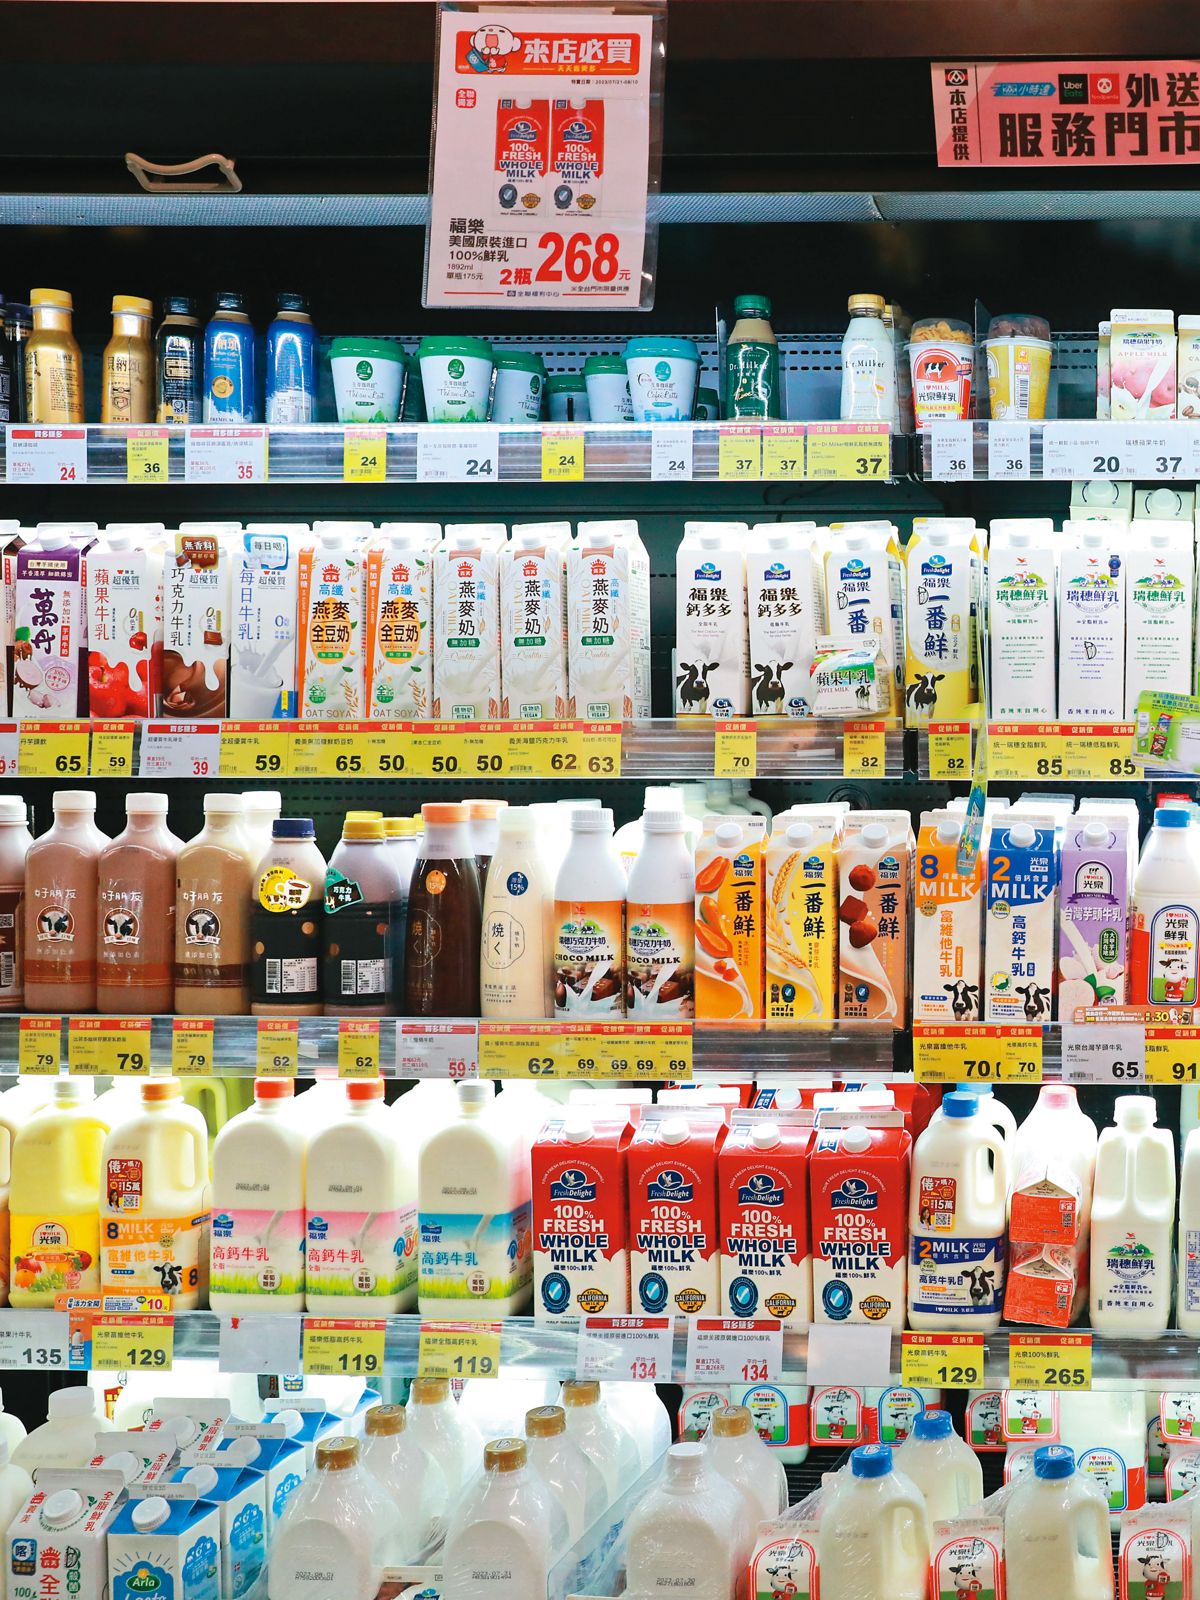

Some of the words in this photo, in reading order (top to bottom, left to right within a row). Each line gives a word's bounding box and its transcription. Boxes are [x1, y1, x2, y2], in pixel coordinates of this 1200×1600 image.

[523, 39, 632, 64] 來店必買
[1063, 81, 1083, 90] Uber
[1126, 73, 1200, 109] 外送
[457, 90, 475, 98] 全聯
[457, 98, 475, 108] 獨家
[950, 89, 970, 161] 本店提供
[510, 143, 535, 152] 100%
[502, 152, 542, 161] FRESH
[500, 161, 543, 171] WHOLE
[506, 170, 536, 178] MILK
[450, 218, 484, 234] 福樂
[449, 235, 528, 248] 美國原裝進口
[450, 251, 509, 262] 100%鮮乳
[500, 268, 532, 286] 2瓶
[535, 232, 620, 282] 268
[620, 270, 630, 280] 元
[918, 392, 958, 402] 光泉鮮乳
[144, 463, 160, 473] 36
[238, 465, 252, 479] 35
[466, 459, 492, 476] 24
[856, 457, 882, 475] 37
[950, 460, 966, 470] 36
[1093, 456, 1120, 472] 20
[60, 467, 76, 480] 24
[690, 587, 730, 602] 福樂
[996, 588, 1048, 602] 瑞穗鮮乳
[94, 568, 110, 641] 蘋果牛乳
[170, 568, 184, 647] 巧克力牛乳
[238, 570, 254, 641] 每日牛乳
[312, 601, 350, 620] 燕麥
[458, 581, 476, 636] 燕麥奶
[686, 602, 733, 617] 鈣多多
[30, 588, 58, 655] 萬丹
[924, 595, 950, 660] 一番鮮
[311, 626, 350, 644] 全豆奶
[816, 671, 870, 686] 蘋果牛乳
[55, 755, 81, 772] 65
[193, 761, 208, 775] 39
[255, 755, 281, 770] 59
[551, 754, 577, 771] 62
[588, 757, 614, 773] 63
[733, 757, 750, 767] 70
[948, 758, 964, 768] 82
[1036, 758, 1062, 775] 85
[920, 855, 938, 879] 8
[992, 857, 1010, 880] 2
[35, 888, 77, 899] 好朋友
[920, 881, 975, 897] MILK
[992, 885, 1047, 899] MILK
[731, 881, 756, 938] 一番鮮
[1064, 906, 1122, 922] 台灣芋頭牛乳
[940, 910, 953, 977] 富維他牛乳
[1012, 915, 1025, 977] 高鈣牛乳
[586, 953, 615, 962] MILK
[117, 1053, 144, 1069] 79
[273, 1056, 290, 1066] 62
[528, 1058, 554, 1074] 62
[578, 1059, 595, 1069] 69
[963, 1061, 990, 1077] 70
[1112, 1062, 1139, 1078] 65
[1172, 1063, 1198, 1080] 91
[554, 1189, 593, 1198] FreshDelight
[553, 1206, 594, 1219] 100%
[107, 1222, 118, 1238] 8
[118, 1223, 153, 1234] MILK
[543, 1219, 604, 1232] FRESH
[39, 1235, 61, 1245] 光泉
[539, 1235, 608, 1249] WHOLE
[108, 1250, 176, 1262] 富維他牛乳
[308, 1249, 364, 1263] 高鈣牛乳
[550, 1250, 597, 1263] MILK
[919, 1241, 932, 1258] 2
[933, 1242, 969, 1253] MILK
[1107, 1258, 1155, 1270] 瑞穗鮮乳
[919, 1275, 957, 1285] 高鈣牛乳
[23, 1349, 62, 1365] 135
[127, 1350, 166, 1366] 129
[338, 1354, 377, 1371] 119
[741, 1364, 768, 1381] 134
[938, 1367, 977, 1383] 129
[1045, 1369, 1085, 1385] 265
[83, 1491, 115, 1532] 全脂鮮乳
[132, 1578, 155, 1589] Arla
